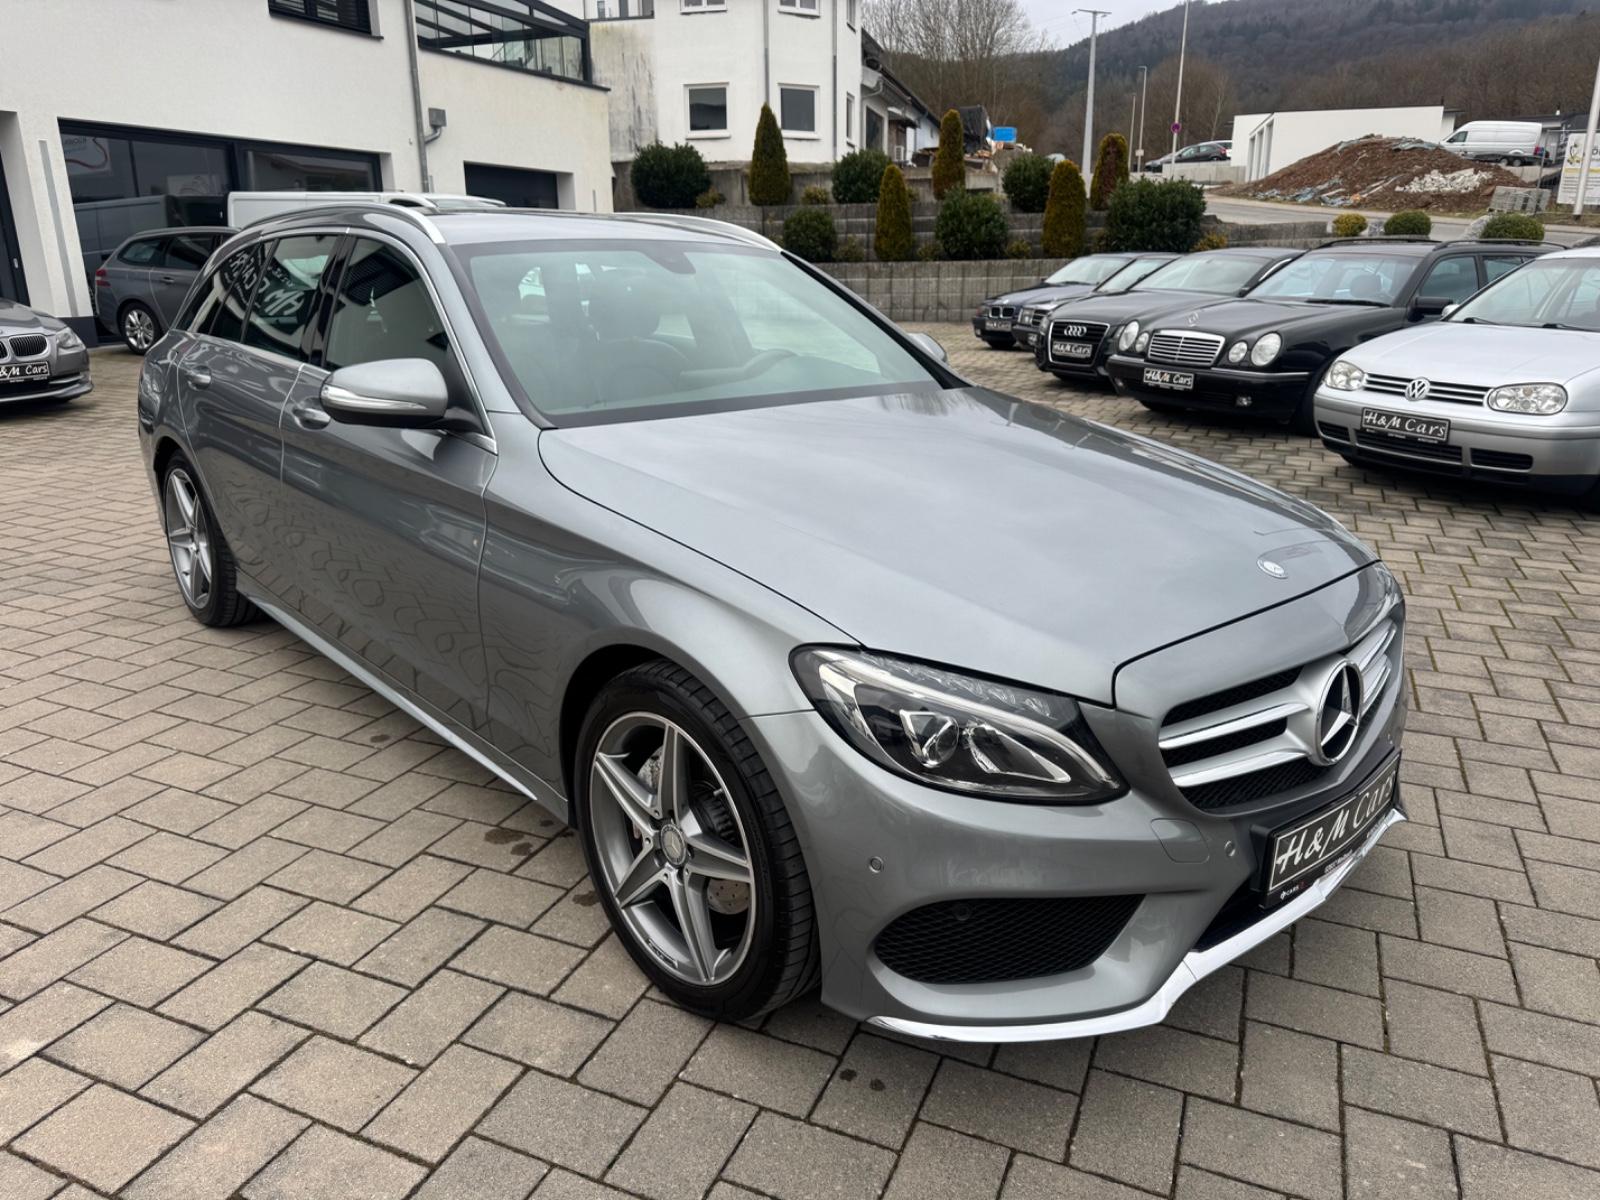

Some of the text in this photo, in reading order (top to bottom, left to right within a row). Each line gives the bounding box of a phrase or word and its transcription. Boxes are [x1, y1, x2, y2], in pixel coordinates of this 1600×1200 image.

[25, 364, 48, 375] Cars
[1172, 373, 1193, 386] Cars
[1364, 411, 1446, 437] H&M Cars
[1275, 808, 1350, 875] H&M
[1353, 770, 1396, 829] Cars
